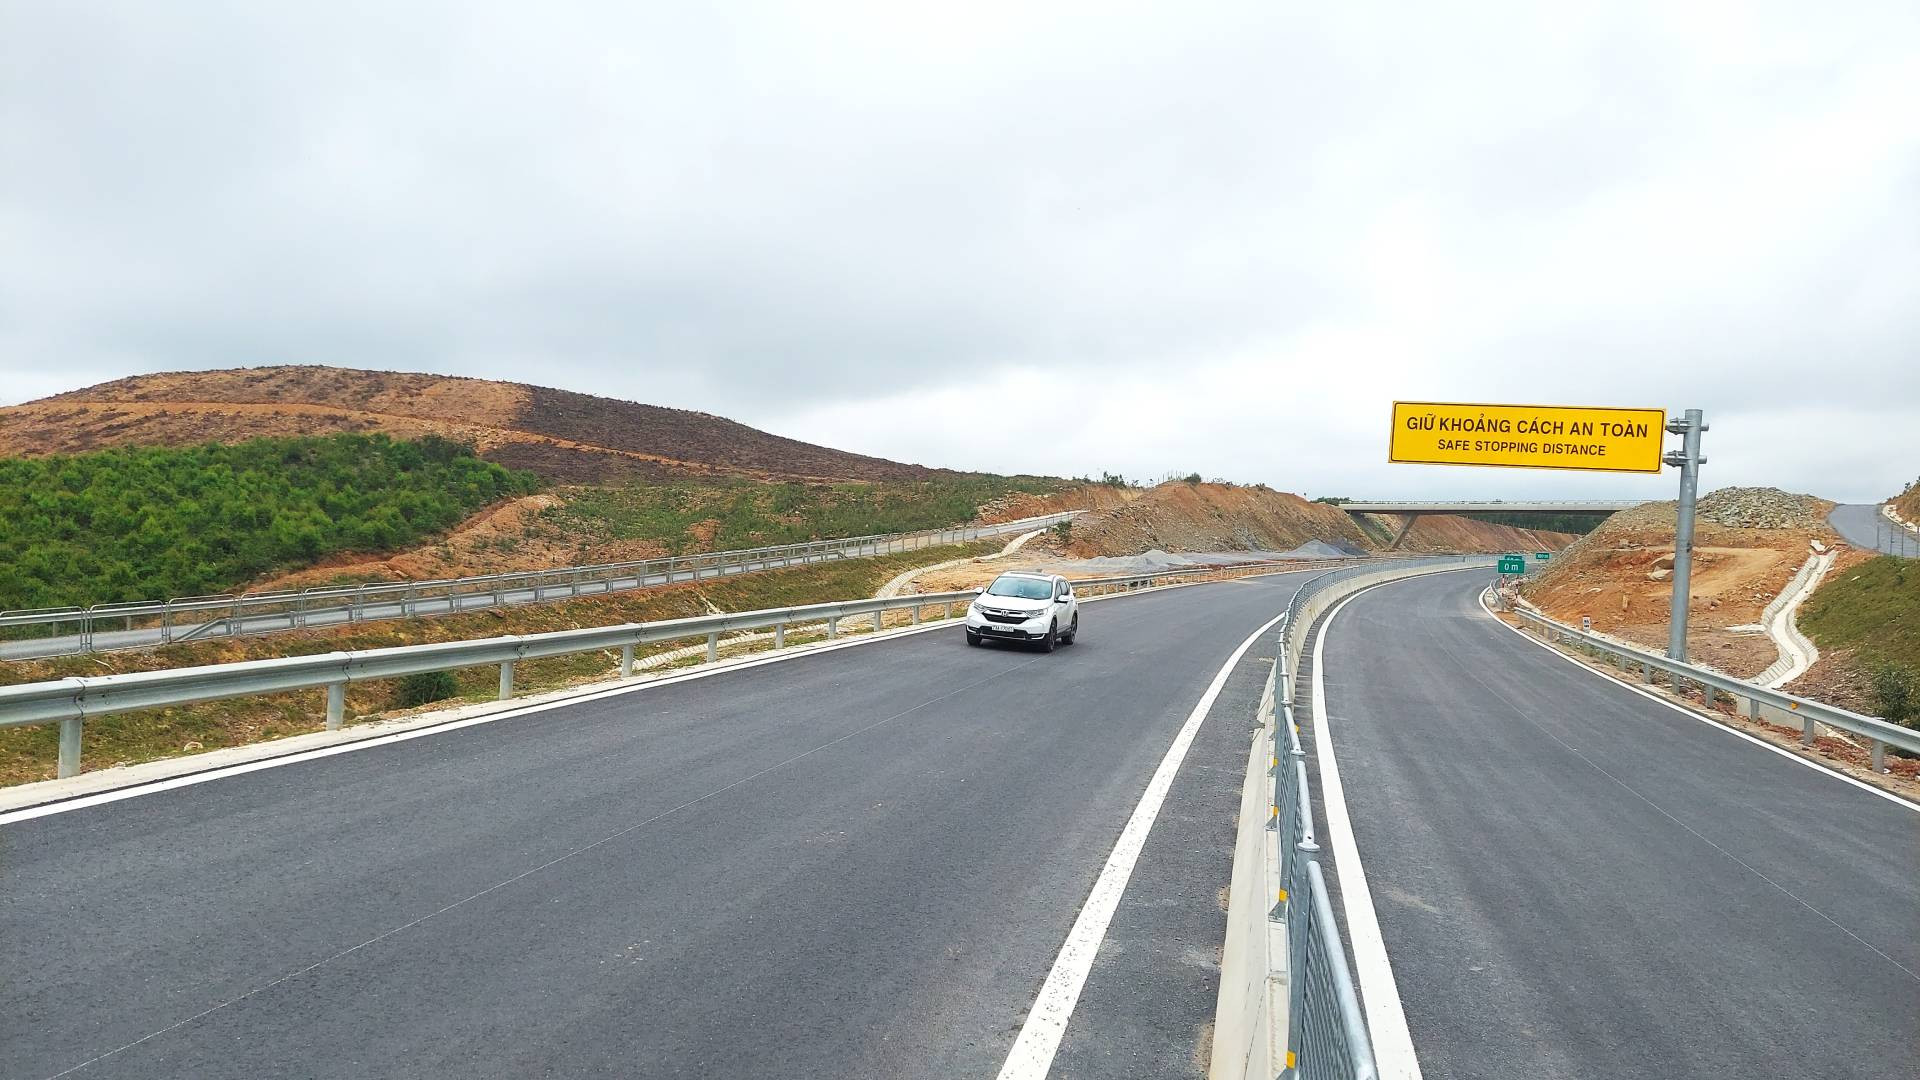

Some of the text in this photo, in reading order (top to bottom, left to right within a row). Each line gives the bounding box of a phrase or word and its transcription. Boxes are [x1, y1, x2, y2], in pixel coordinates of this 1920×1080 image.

[1406, 412, 1648, 438] GIỮ KHOẢNG CÁCH AN TOÀN
[1438, 439, 1606, 456] SAFE STOPPING DISTANCE
[1504, 563, 1510, 571] 0
